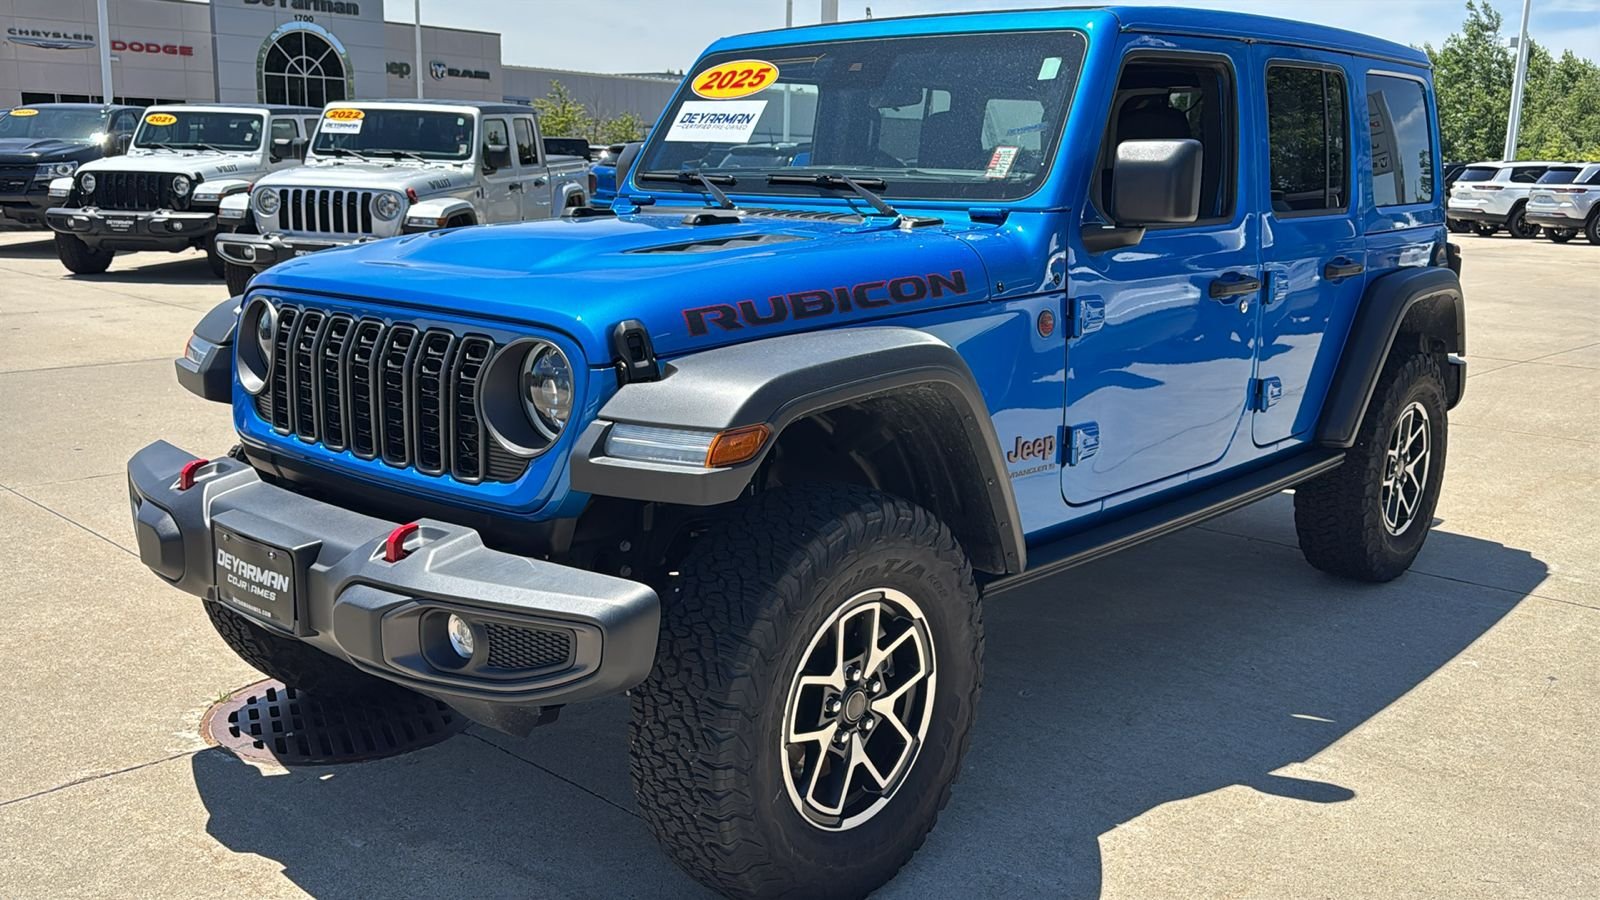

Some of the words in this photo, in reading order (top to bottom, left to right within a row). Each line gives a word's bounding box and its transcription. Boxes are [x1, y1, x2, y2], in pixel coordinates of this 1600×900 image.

[244, 0, 359, 16] earman
[294, 14, 314, 23] 1700
[7, 28, 94, 41] CHRYSLER
[111, 40, 193, 56] DODGE
[447, 68, 490, 80] RAM
[699, 68, 771, 91] 2025
[330, 111, 362, 119] 2022
[680, 112, 756, 124] DEYARMAN
[682, 269, 967, 337] RUBICON
[1007, 435, 1056, 464] Jeep
[217, 548, 290, 593] DEYARMAN
[250, 584, 277, 601] AMES
